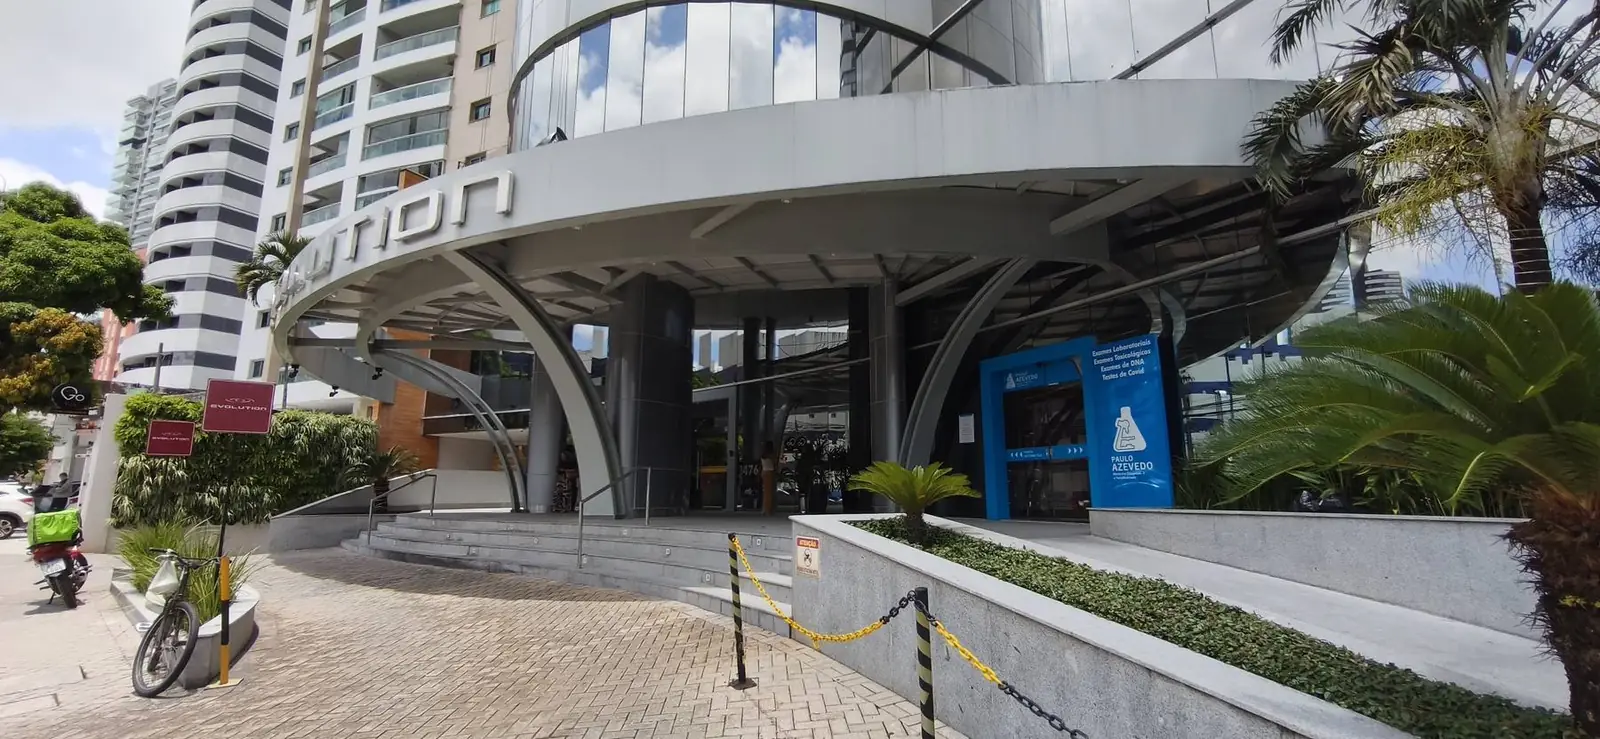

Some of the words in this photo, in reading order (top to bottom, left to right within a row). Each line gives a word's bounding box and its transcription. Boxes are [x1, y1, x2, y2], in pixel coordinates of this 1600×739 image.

[1092, 348, 1111, 357] Exames
[1113, 339, 1151, 353] Laboratoriais
[1094, 356, 1113, 365] Exames
[1114, 349, 1151, 361] Toxicológicos
[1100, 363, 1121, 372] Exames
[1130, 358, 1144, 367] DNA
[1102, 373, 1118, 381] Testes
[1128, 367, 1144, 376] Covid
[1111, 455, 1134, 463] PAULO
[1112, 461, 1153, 472] AZEVEDO
